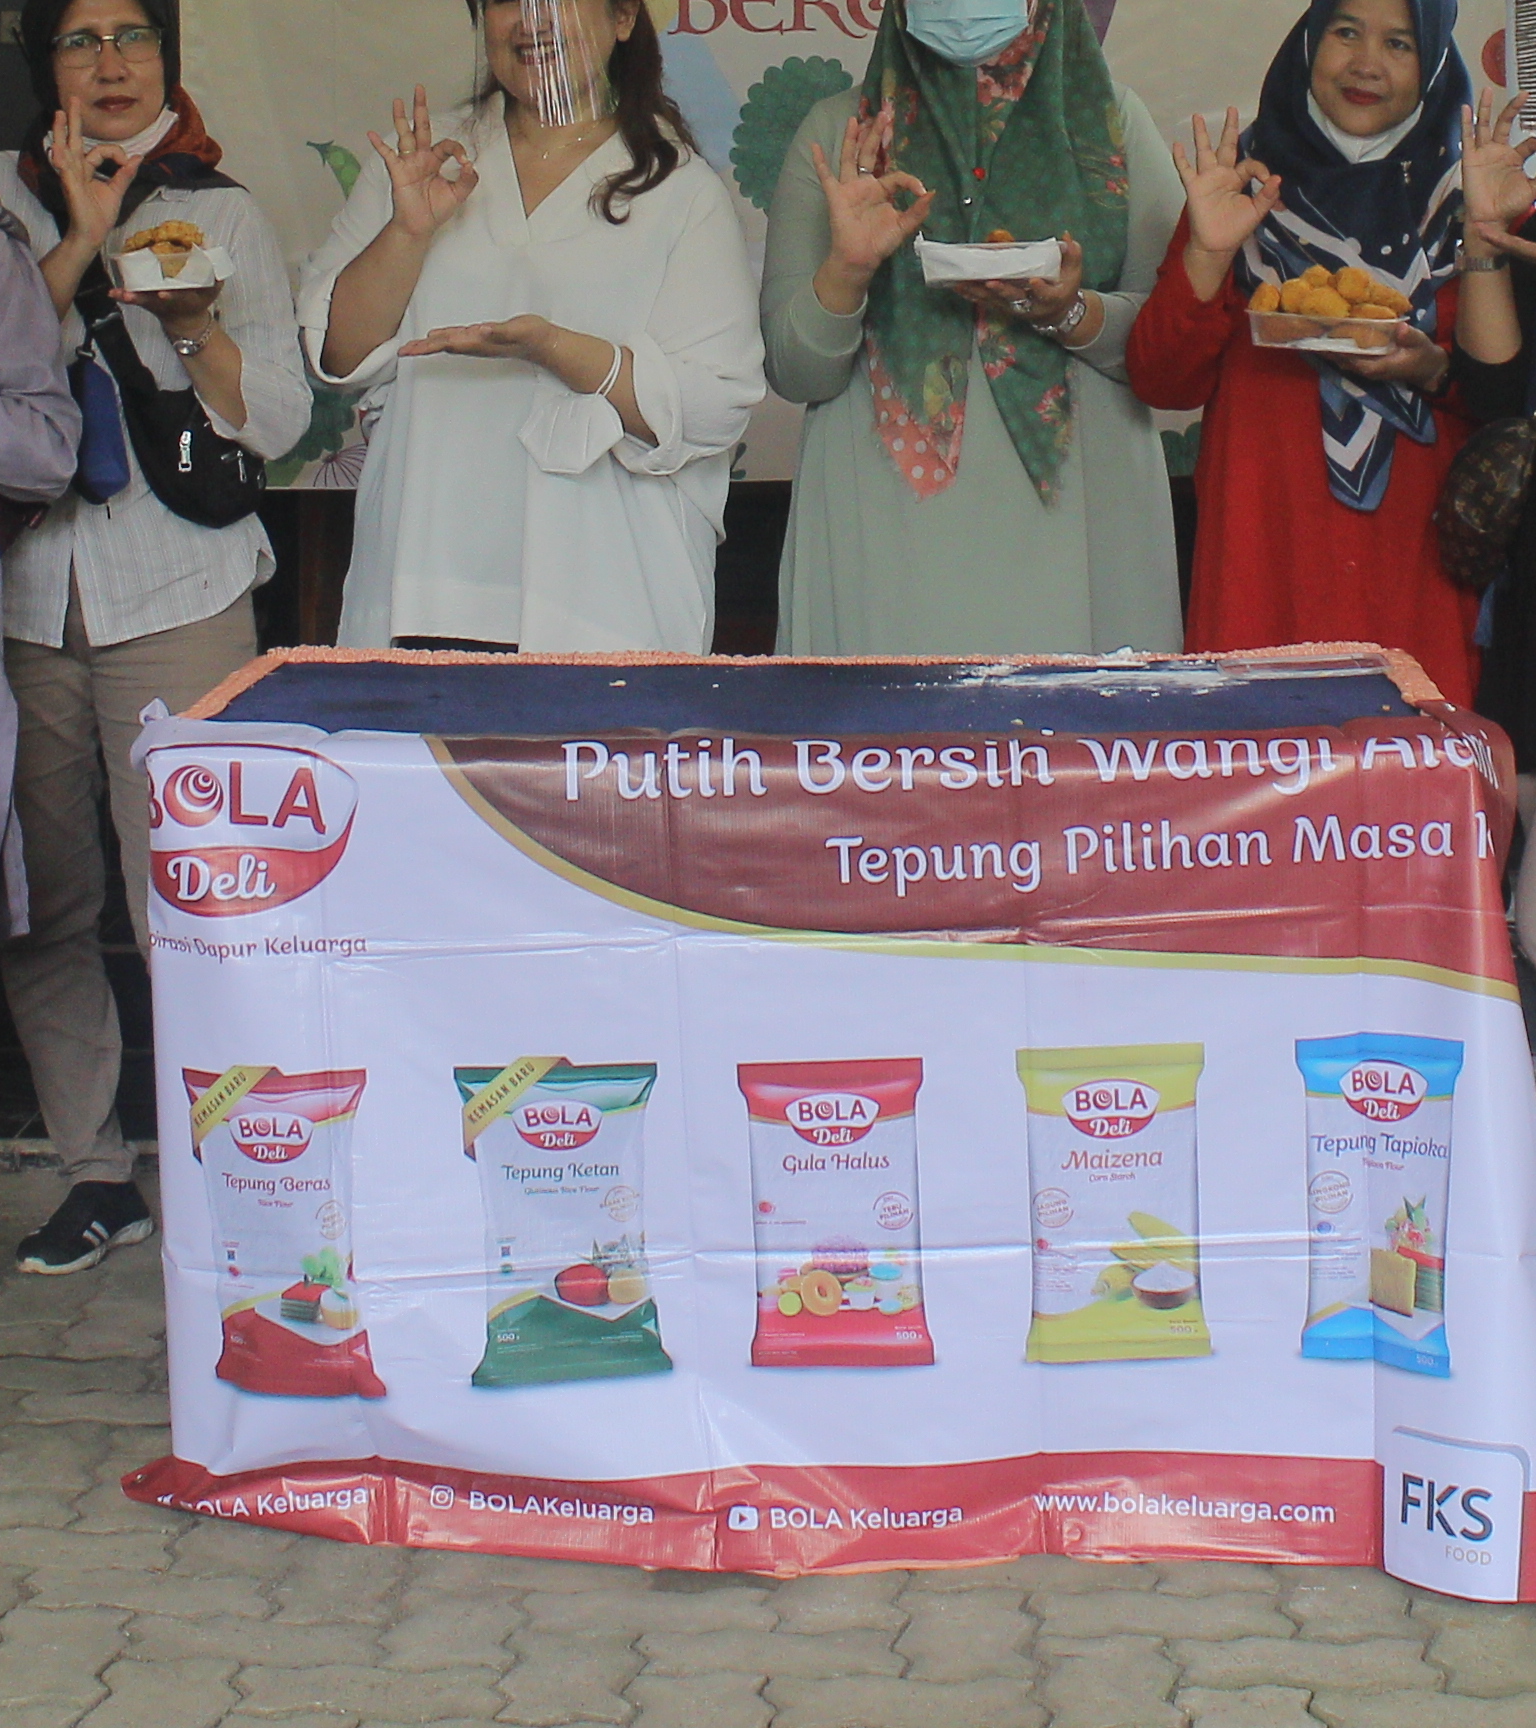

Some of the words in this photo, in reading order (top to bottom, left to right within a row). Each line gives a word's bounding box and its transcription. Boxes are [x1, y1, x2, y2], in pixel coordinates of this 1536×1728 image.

[562, 738, 766, 802] Putih
[795, 731, 1053, 796] Bersih
[826, 833, 1041, 894] Tepung
[1065, 819, 1275, 878] Pilihan
[1292, 815, 1455, 865] Masa
[166, 854, 276, 902] Deli
[193, 938, 257, 964] Dapur
[264, 936, 368, 957] Keluarga
[223, 1072, 247, 1097] BARU
[468, 1085, 510, 1125] KEMASAN
[510, 1063, 536, 1090] BARU
[1352, 1070, 1416, 1096] BOLA
[798, 1100, 867, 1122] BOLA
[1075, 1088, 1148, 1111] BOLA
[1362, 1100, 1401, 1120] Deli
[239, 1116, 304, 1141] BOLA
[524, 1107, 594, 1128] BOLA
[1089, 1118, 1133, 1136] Deli
[539, 1133, 577, 1147] Deli
[812, 1129, 854, 1145] Deli
[1311, 1134, 1376, 1157] Tepung
[1380, 1133, 1448, 1160] Tapioka
[252, 1144, 288, 1161] Deli
[782, 1154, 826, 1176] Gula
[830, 1151, 890, 1170] Halus
[1061, 1150, 1163, 1171] Maizena
[221, 1173, 276, 1195] Tepung
[280, 1176, 330, 1192] Beras
[501, 1164, 563, 1183] Tepung
[568, 1163, 619, 1178] Ketan
[181, 1496, 249, 1518] OLA
[258, 1485, 368, 1515] Keluarga
[468, 1492, 655, 1525] BOLAKeluarga
[1034, 1490, 1336, 1526] www.bolakeluarga.com
[1398, 1472, 1495, 1544] FKS
[770, 1506, 842, 1530] BOLA
[850, 1503, 964, 1532] Keluarga
[1444, 1545, 1493, 1567] FOOD
